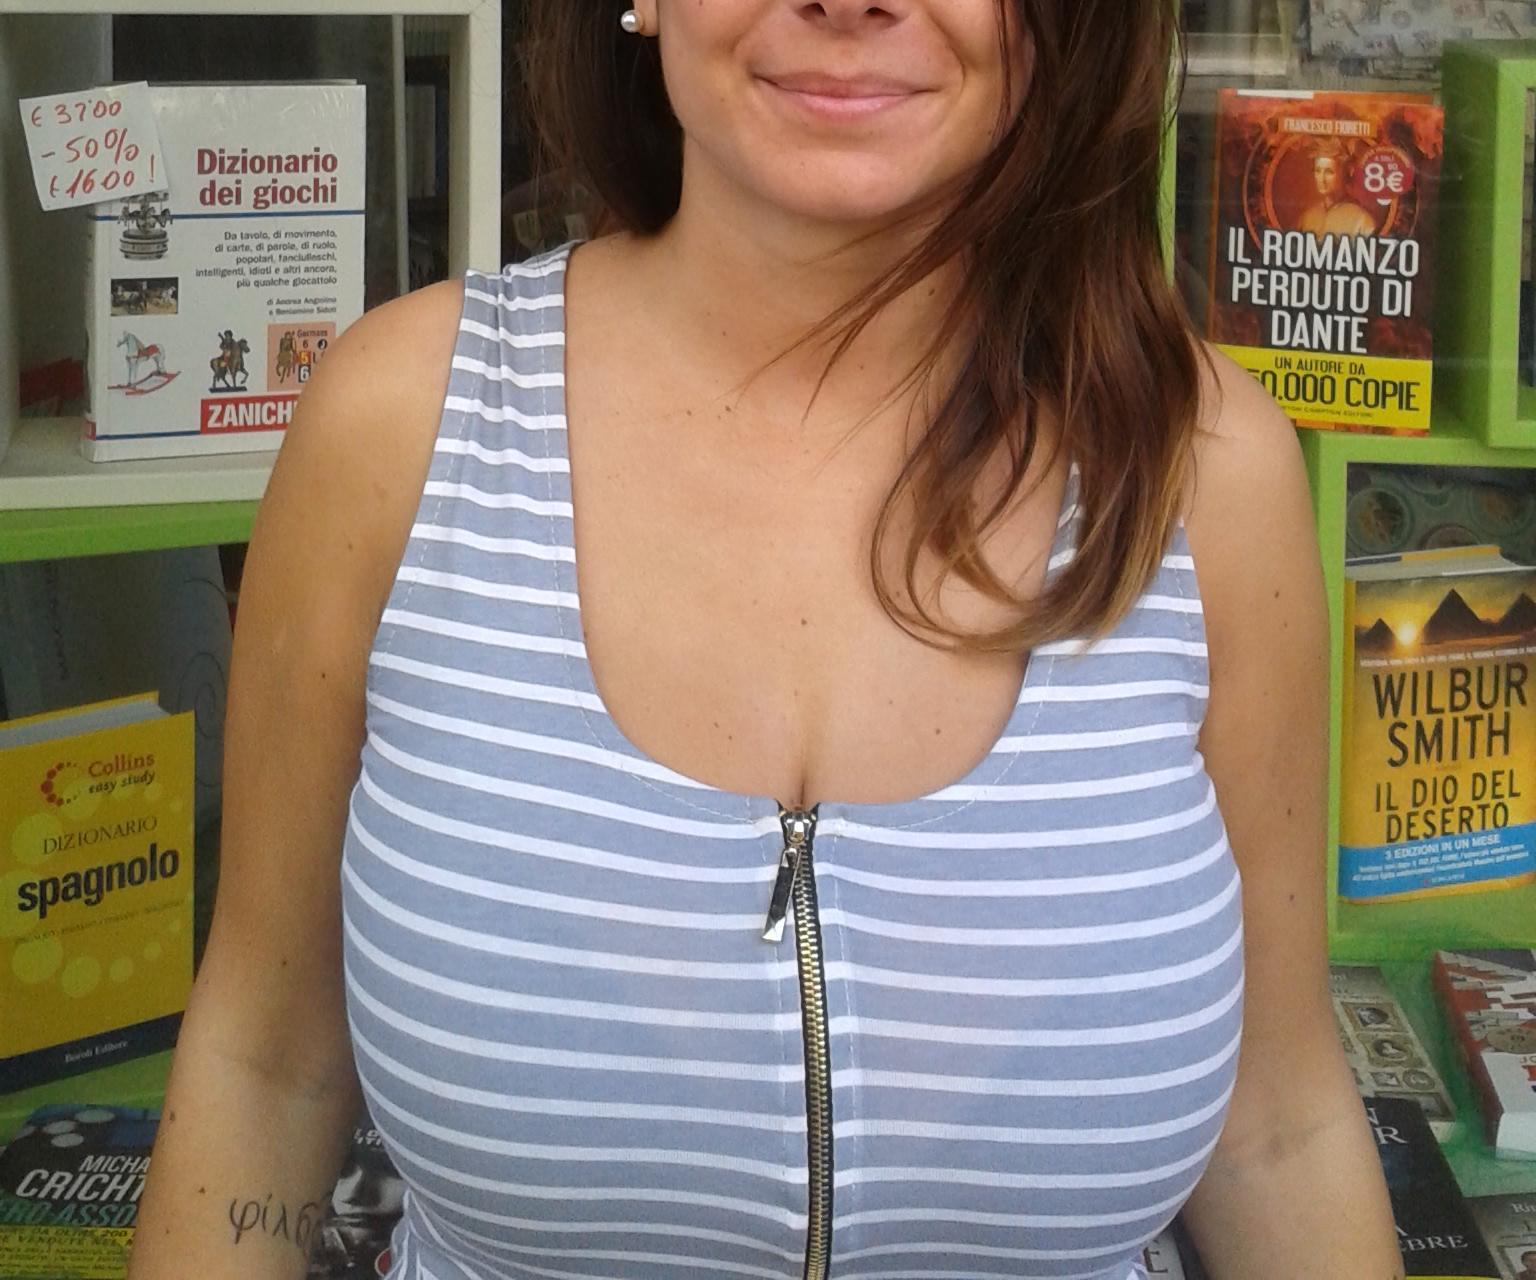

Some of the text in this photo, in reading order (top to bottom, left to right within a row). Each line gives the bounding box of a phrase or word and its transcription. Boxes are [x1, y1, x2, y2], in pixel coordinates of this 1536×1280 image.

[197, 146, 338, 175] Dizionario
[199, 177, 338, 210] dei giochi
[215, 244, 224, 253] di
[255, 242, 265, 252] di
[300, 241, 310, 250] di
[224, 229, 338, 241] Da tavolo, di movimento,
[1228, 227, 1420, 277] IL ROMANZO
[253, 278, 290, 288] qualche
[292, 277, 338, 287] giocattolo
[282, 265, 301, 274] altri
[1231, 267, 1412, 317] PERDUTO DI
[1271, 309, 1369, 353] DANTE
[1275, 356, 1366, 376] UN AUTORE DA
[1345, 377, 1421, 411] COPIE
[207, 400, 298, 428] ZANICH
[1372, 661, 1529, 719] WILBUR
[1387, 711, 1511, 768] SMITH
[88, 753, 156, 778] Collins
[89, 771, 156, 794] easy study
[1375, 768, 1521, 813] IL DIO DEL
[43, 816, 157, 855] DIZIONARIO
[1386, 801, 1509, 844] DESERTO
[1454, 838, 1469, 849] UN
[1471, 834, 1501, 847] MESE
[17, 842, 180, 919] spagnolo
